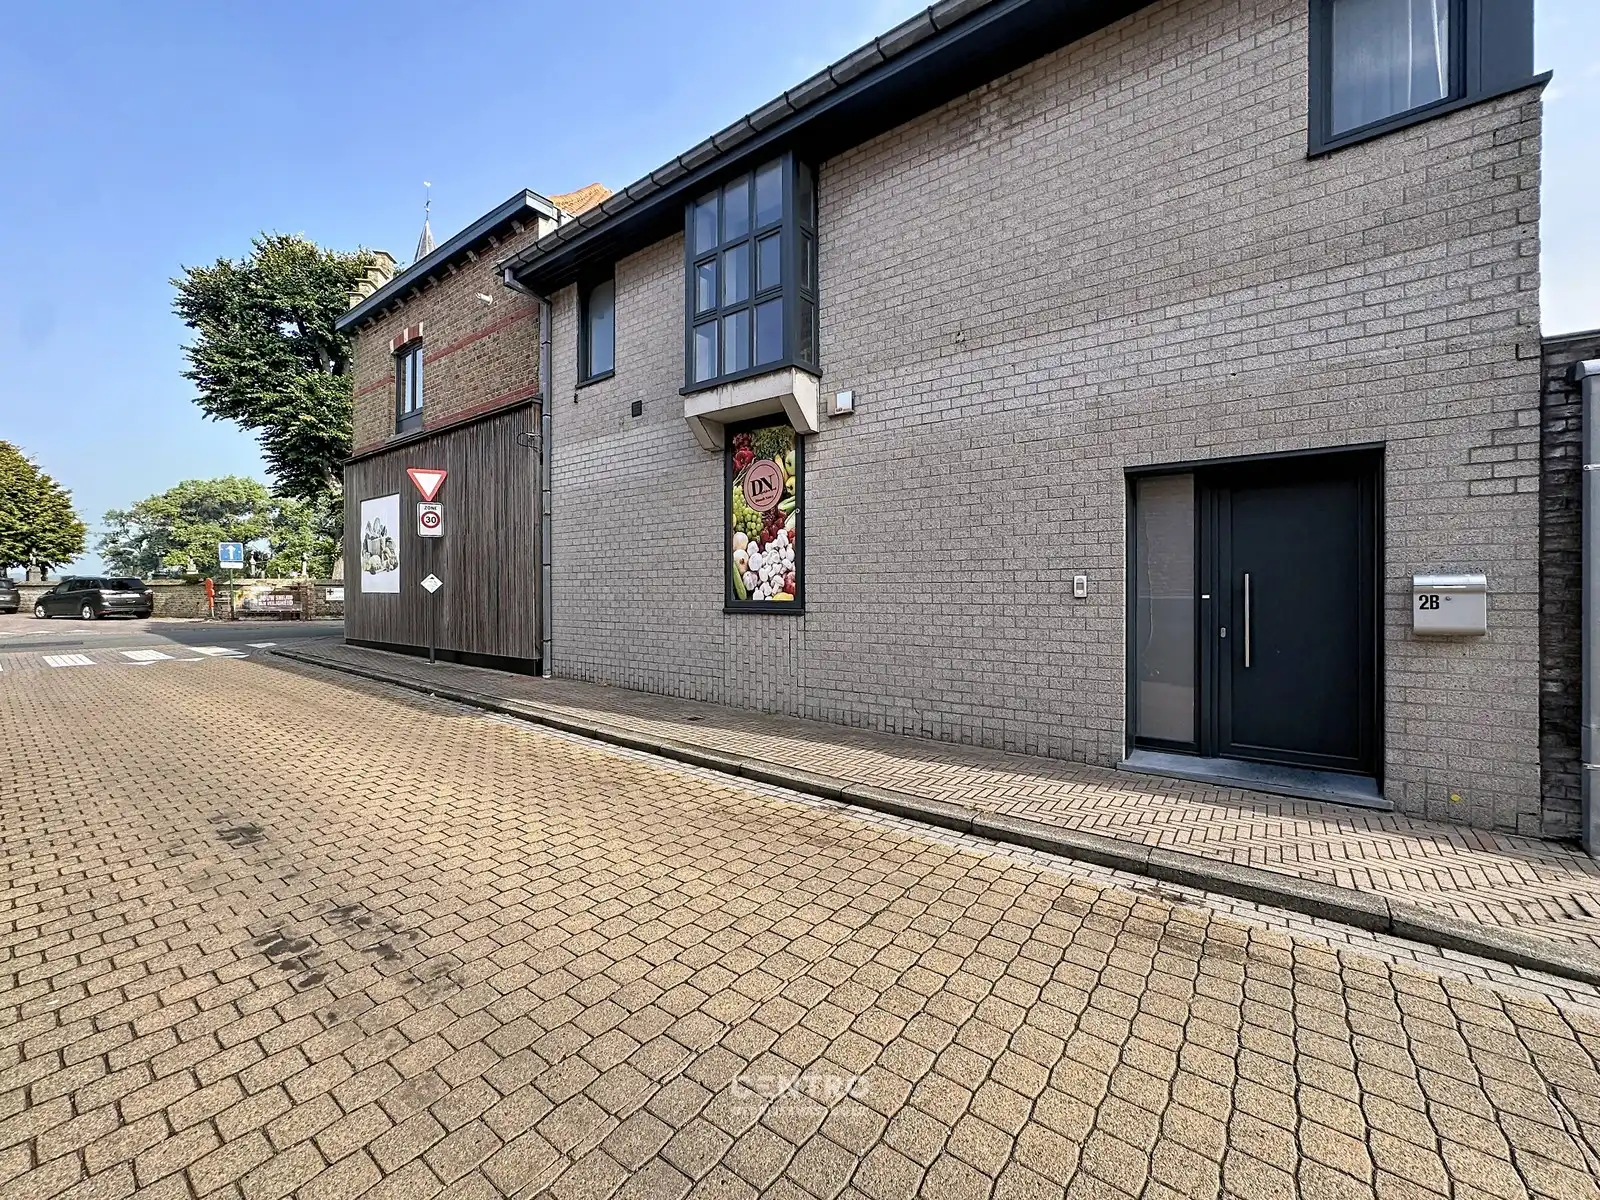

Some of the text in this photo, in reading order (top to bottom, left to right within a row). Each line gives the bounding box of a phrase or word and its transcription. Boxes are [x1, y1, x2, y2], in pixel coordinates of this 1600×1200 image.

[750, 474, 777, 498] DN
[425, 516, 437, 524] 30
[1418, 594, 1440, 610] 2B
